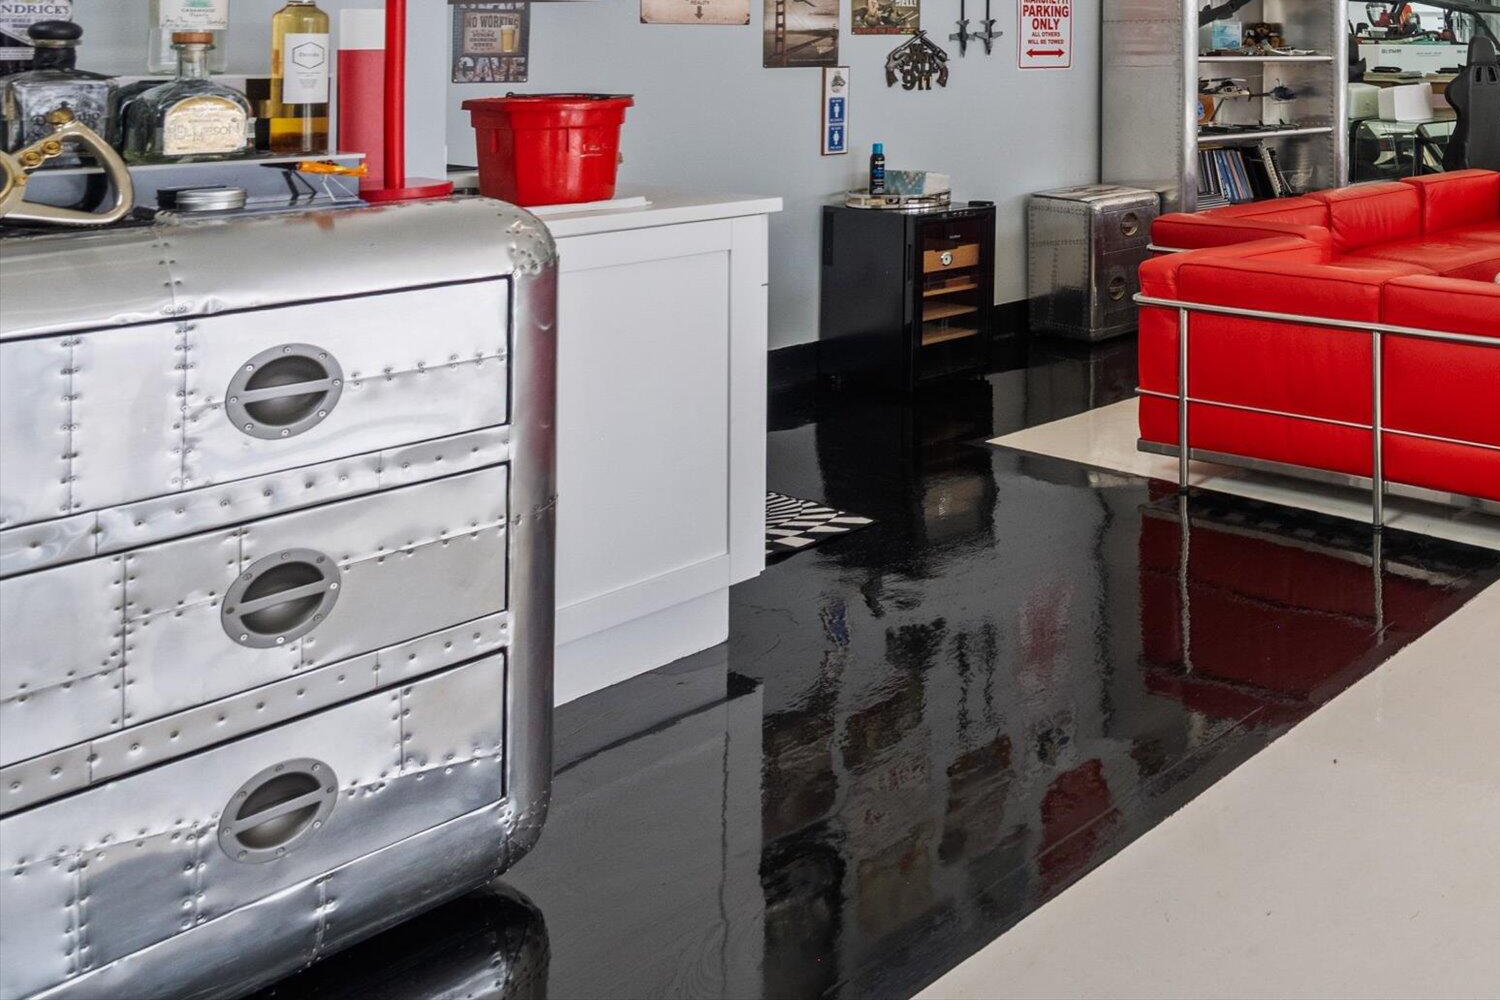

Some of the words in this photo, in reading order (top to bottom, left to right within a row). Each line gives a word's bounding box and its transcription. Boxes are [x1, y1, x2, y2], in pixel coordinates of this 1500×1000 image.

[0, 4, 70, 14] NDRICK'S
[1022, 4, 1069, 17] PARKING
[1032, 18, 1060, 30] ONLY
[457, 57, 526, 81] CAVE
